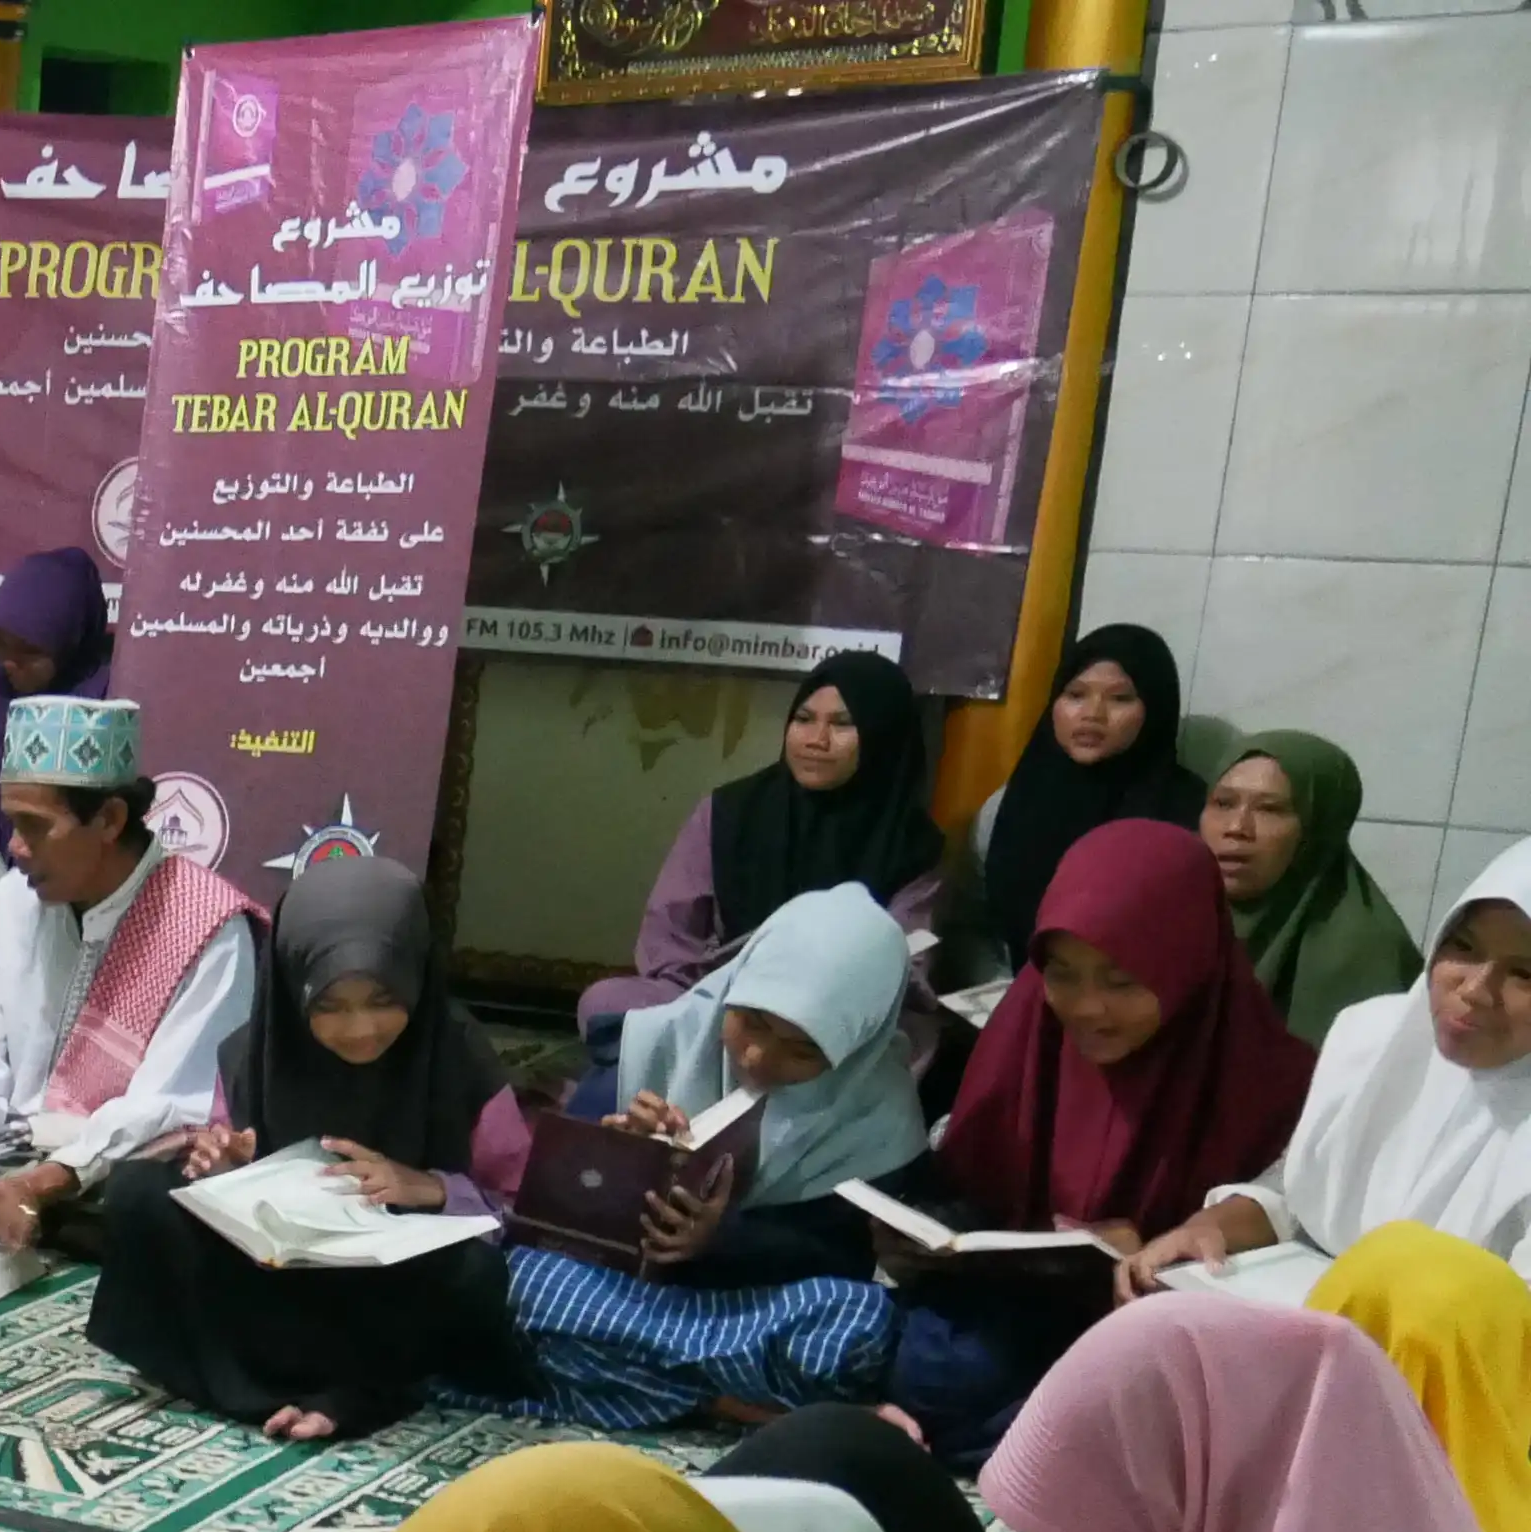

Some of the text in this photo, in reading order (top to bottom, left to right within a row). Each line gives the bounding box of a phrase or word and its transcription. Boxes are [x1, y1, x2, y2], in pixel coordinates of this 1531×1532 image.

[544, 131, 787, 212] مشروع
[272, 201, 401, 252] مشروع
[391, 259, 491, 308] توزيع
[508, 237, 780, 317] L-QURAN
[64, 324, 153, 354] حسنين
[571, 327, 689, 364] الطباعة
[236, 335, 410, 378] PROGRAM
[608, 387, 660, 411] منه
[677, 380, 723, 412] الله
[738, 386, 814, 423] تقبل
[171, 389, 468, 440] TEBAR AL-QURAN
[212, 471, 415, 504] الطباعة والتوزيع
[158, 518, 271, 547] المحسنين
[335, 519, 389, 542] نفقة
[399, 520, 445, 549] على
[275, 572, 314, 594] منه
[325, 563, 359, 595] الله
[368, 574, 424, 602] تقبل
[130, 611, 251, 641] والمسلمين
[466, 617, 880, 662] FM 105.3 Mhz info@mimbar.o
